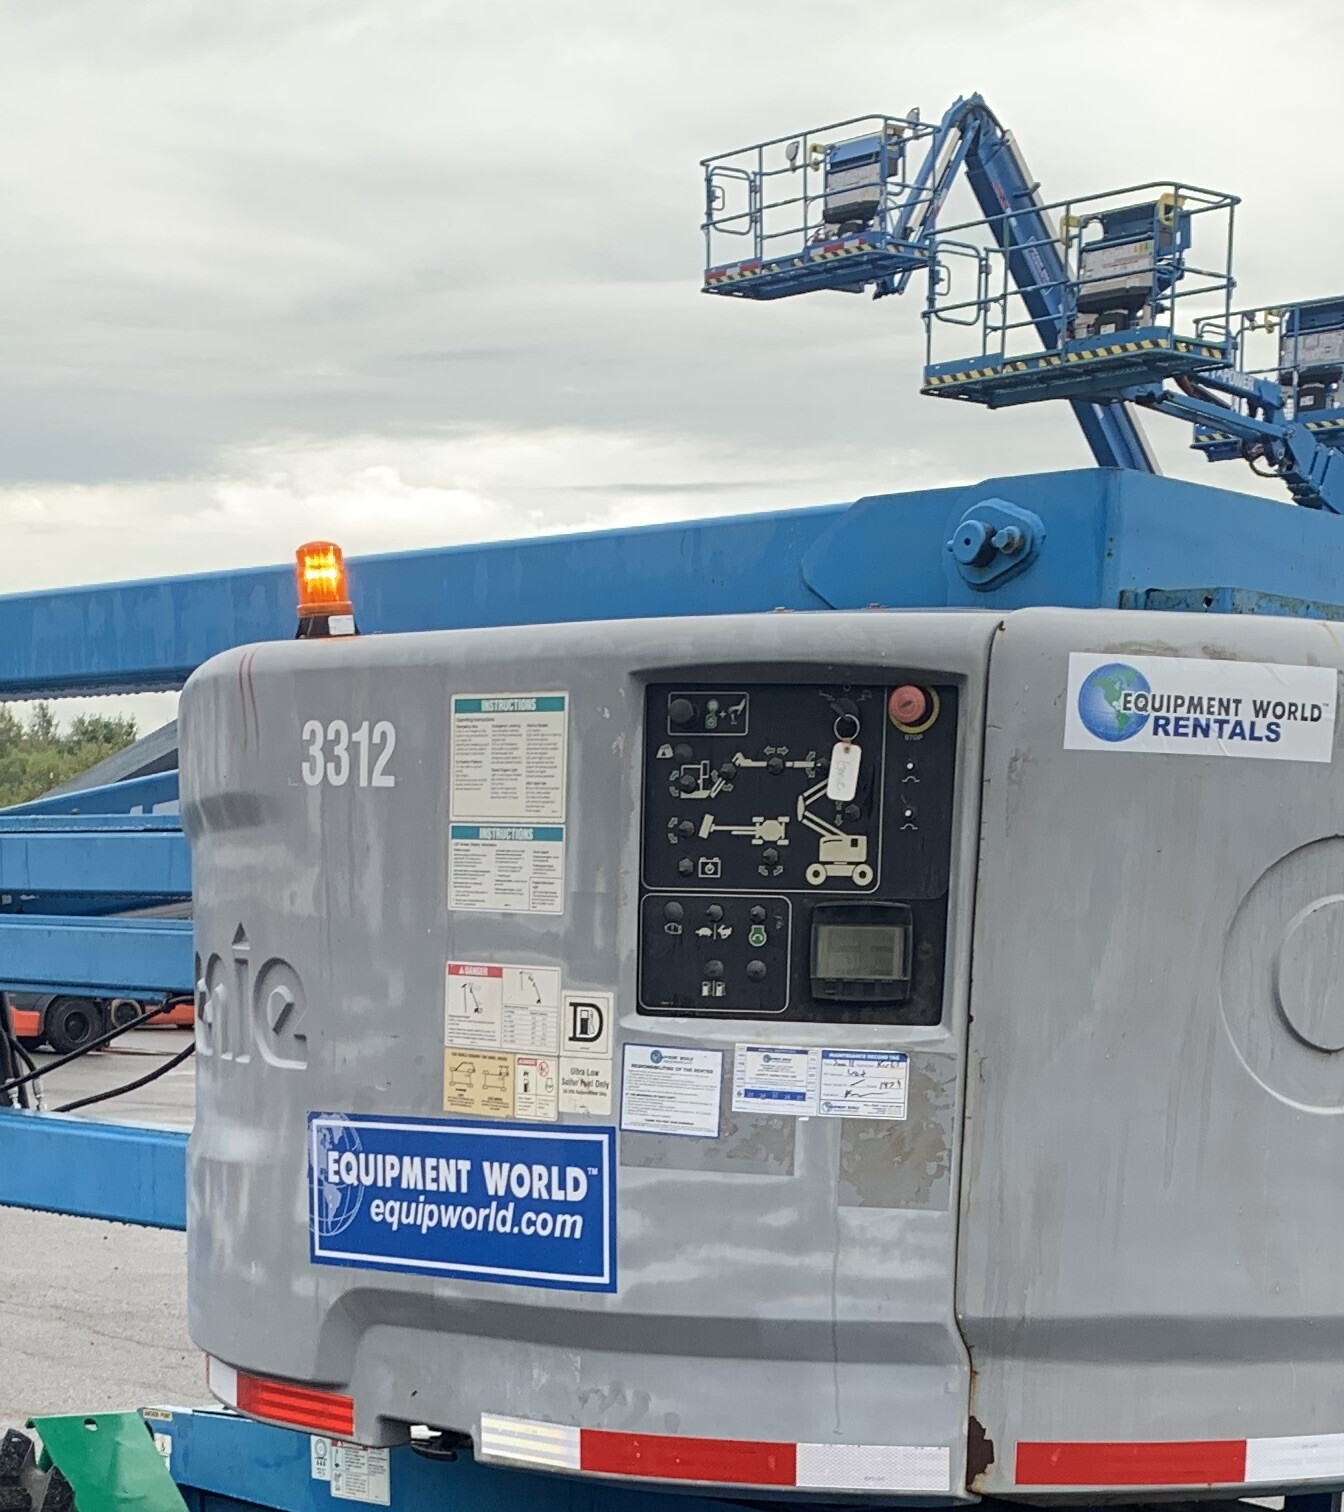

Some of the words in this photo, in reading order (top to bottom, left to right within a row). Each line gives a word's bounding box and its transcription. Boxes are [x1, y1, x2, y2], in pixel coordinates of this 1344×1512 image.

[481, 698, 536, 712] INSTRUCTIONS
[1121, 692, 1242, 717] EQUIPMENT
[1152, 715, 1282, 743] RENTALS
[301, 719, 397, 788] 3312
[327, 1150, 471, 1194] EQUIPMENT
[370, 1195, 583, 1240] equipworld.com
